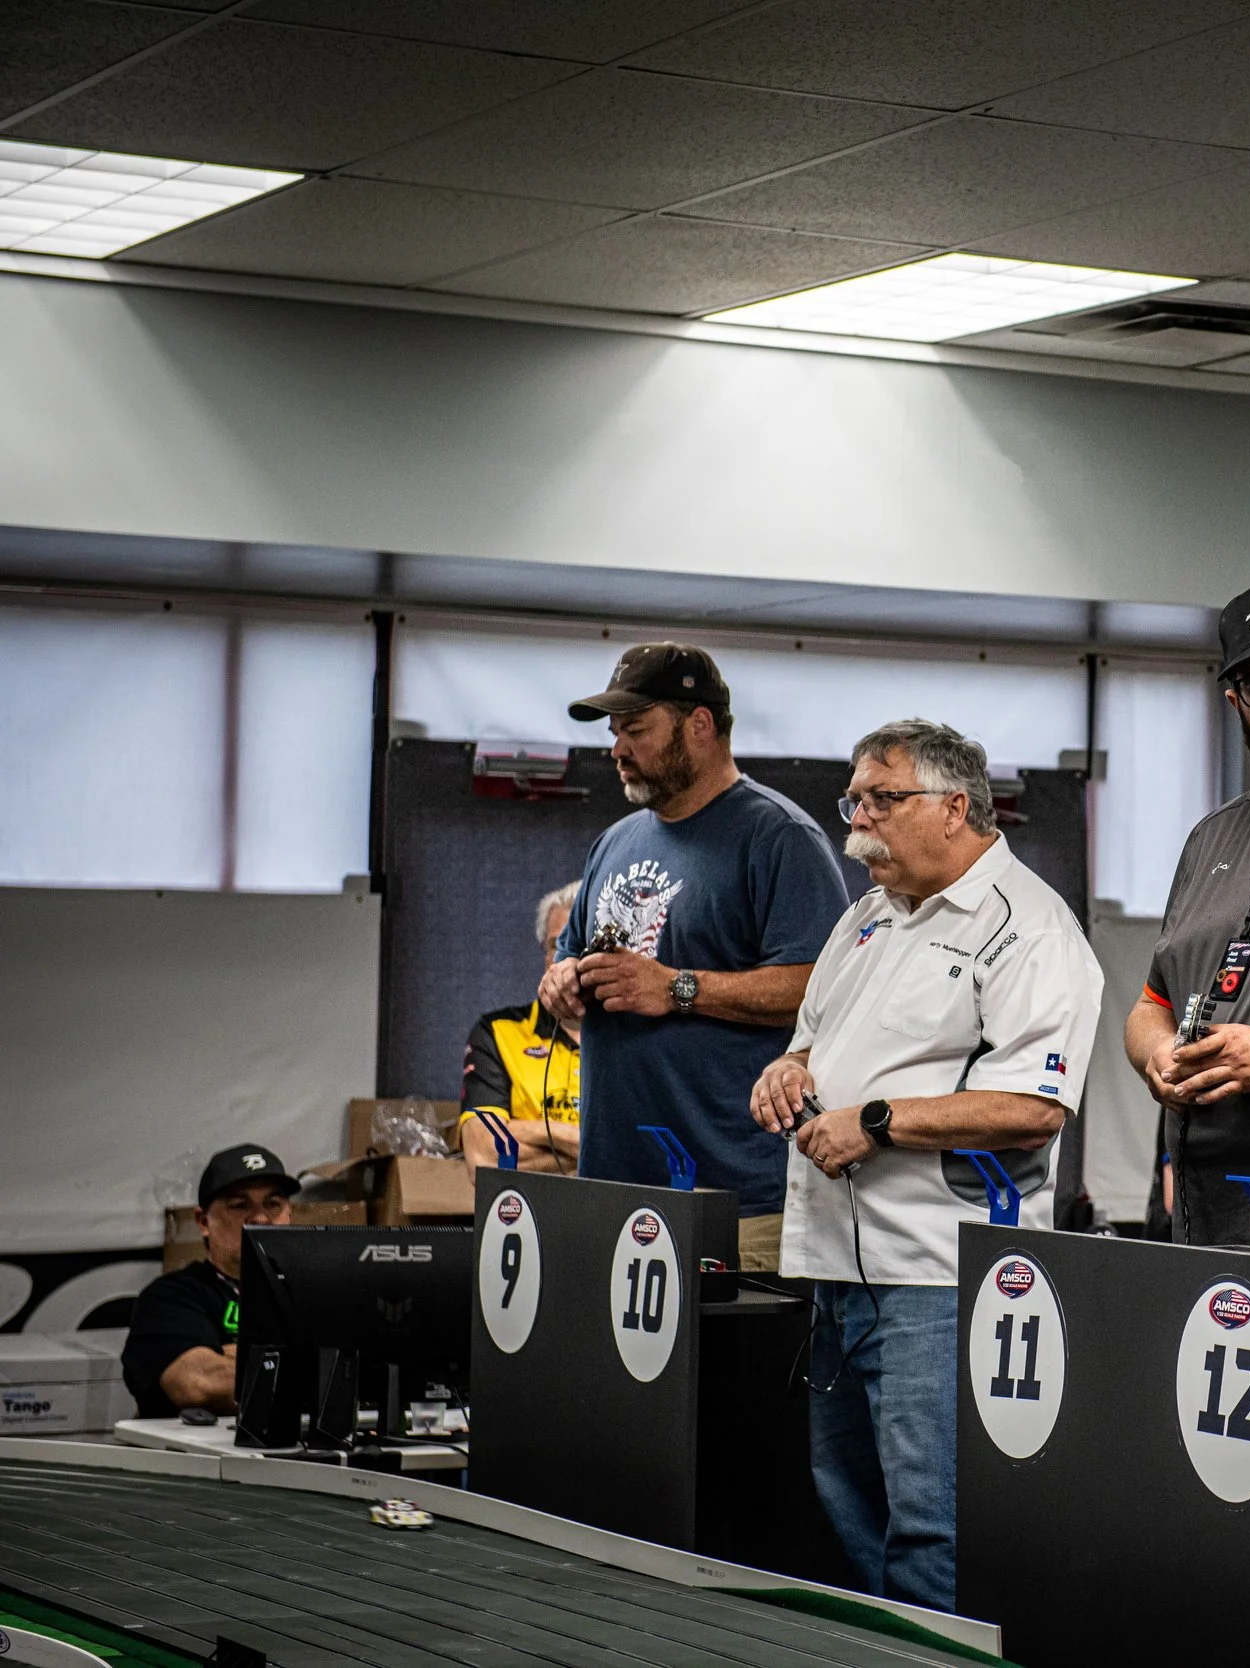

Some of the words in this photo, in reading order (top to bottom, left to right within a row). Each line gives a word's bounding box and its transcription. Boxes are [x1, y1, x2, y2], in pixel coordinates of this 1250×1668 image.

[634, 1223, 658, 1234] AMSCO
[359, 1244, 433, 1262] ASUS
[501, 1233, 522, 1309] 9
[1000, 1272, 1032, 1283] AMSCO
[622, 1258, 667, 1333] 10
[1213, 1299, 1250, 1315] AMSCO
[990, 1314, 1041, 1400] 11
[3, 1399, 52, 1416] Tango
